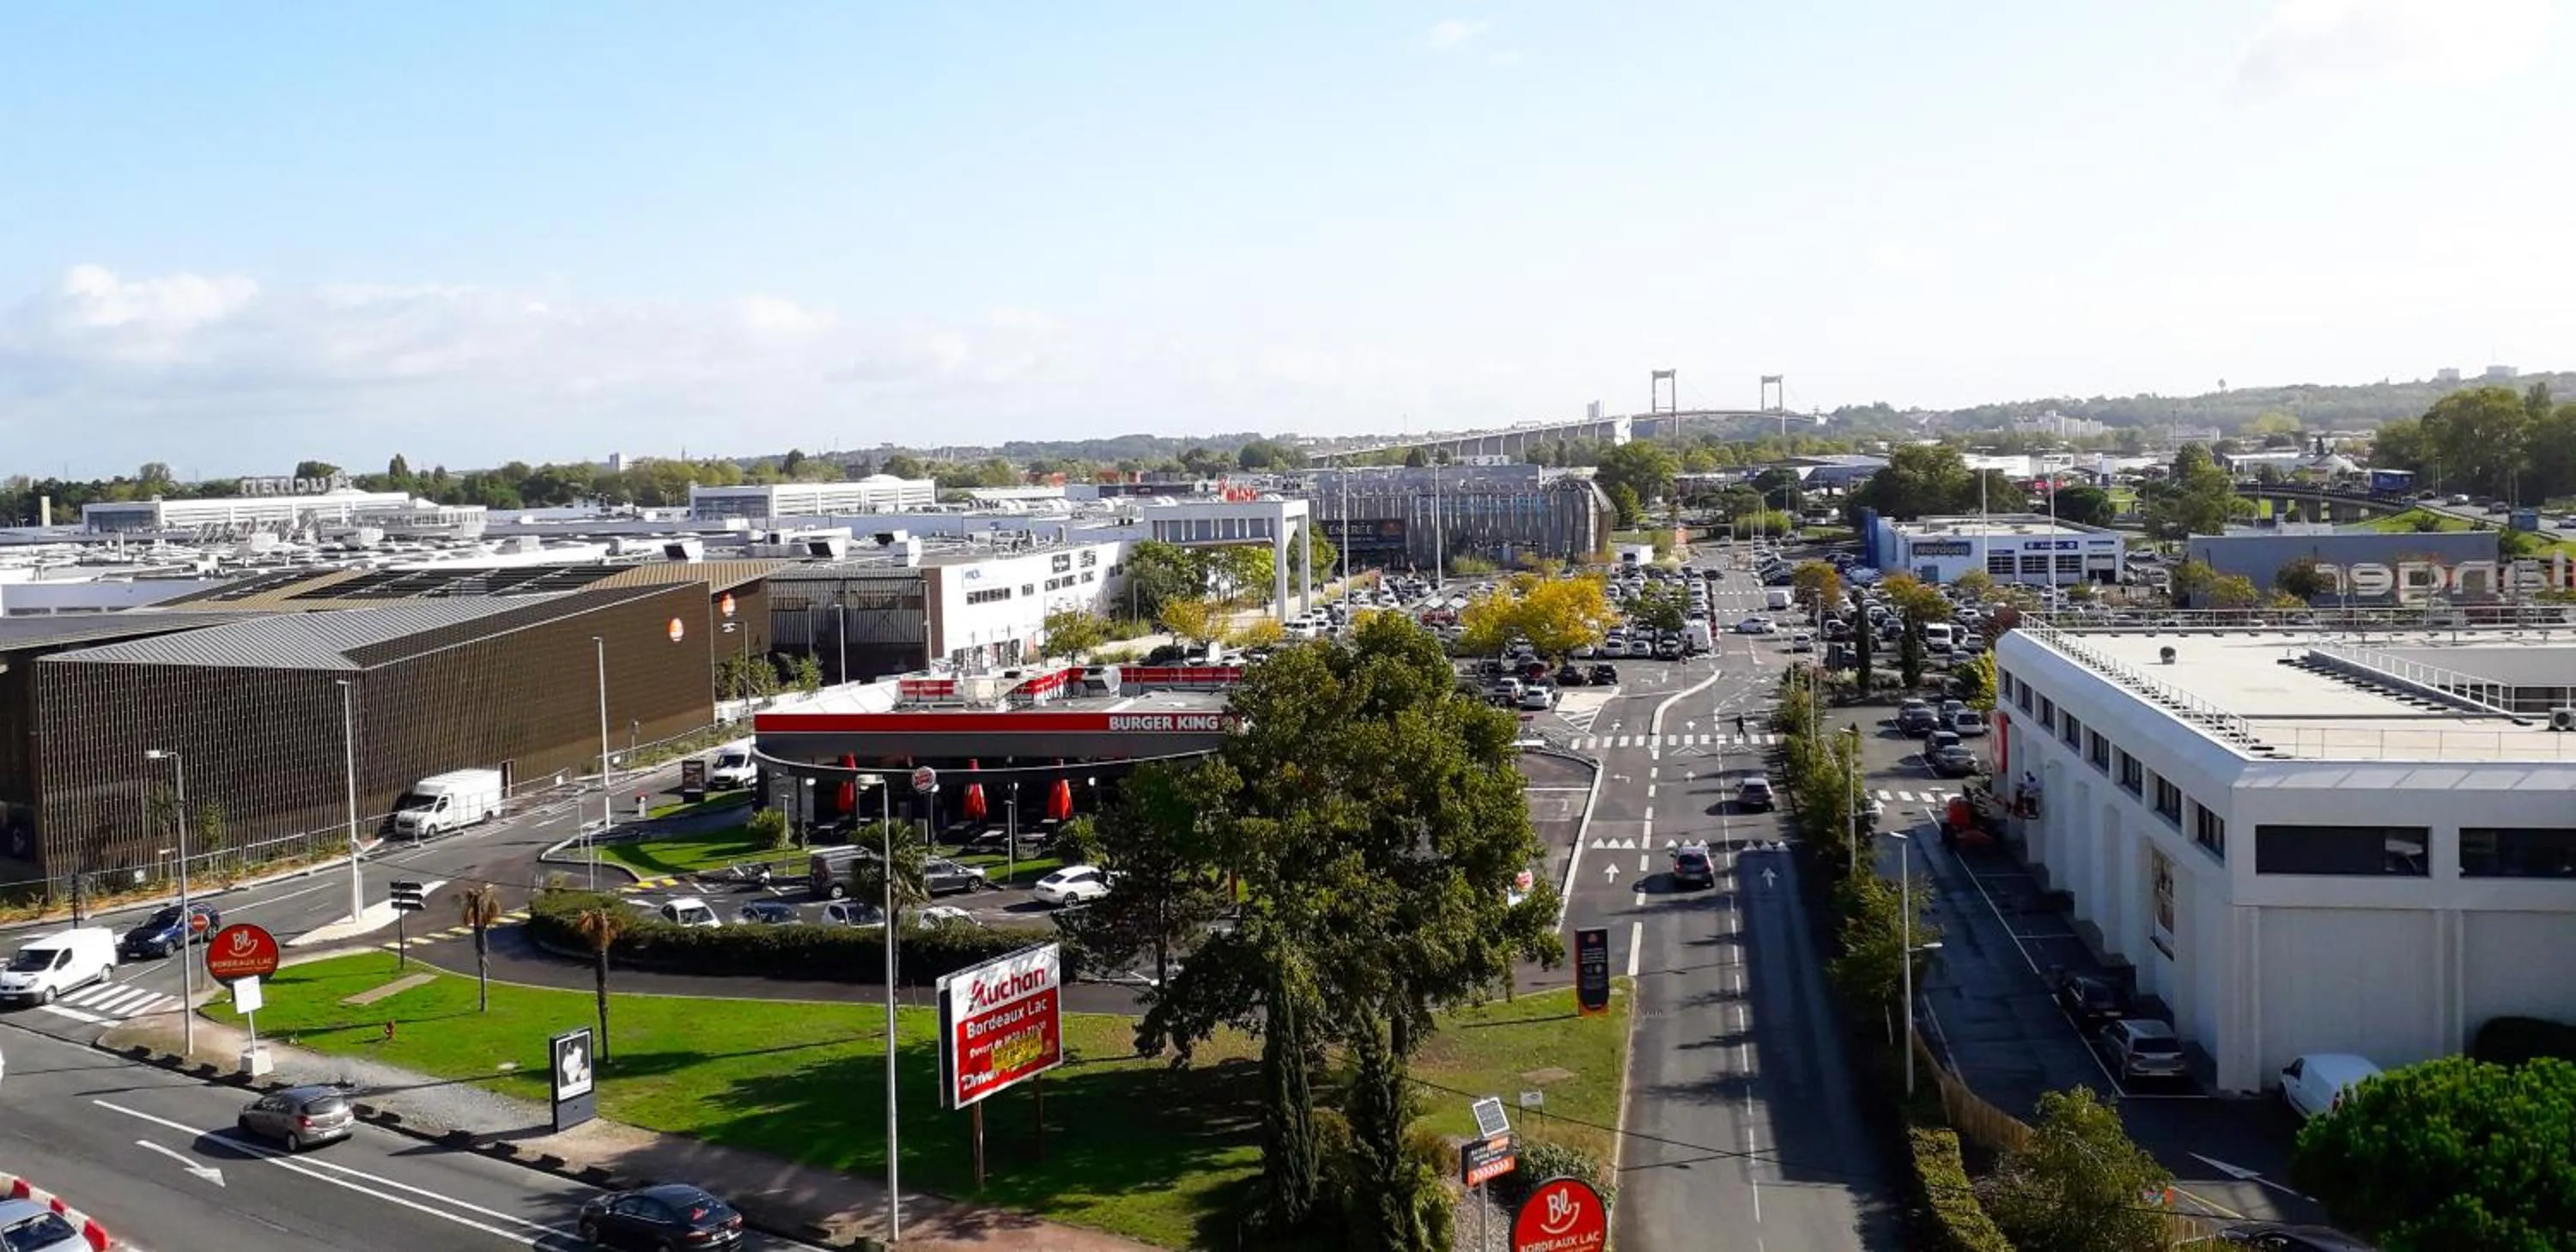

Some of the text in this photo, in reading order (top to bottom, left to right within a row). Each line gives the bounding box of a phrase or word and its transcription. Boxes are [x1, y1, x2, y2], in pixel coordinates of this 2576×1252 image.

[1328, 522, 1373, 534] ENRÉE
[1109, 715, 1218, 730] BURGER KING
[969, 968, 1046, 1011] Auchan
[966, 1006, 1024, 1039] Bordeaux
[1027, 999, 1048, 1016] Lac
[1580, 1231, 1601, 1245] LAC
